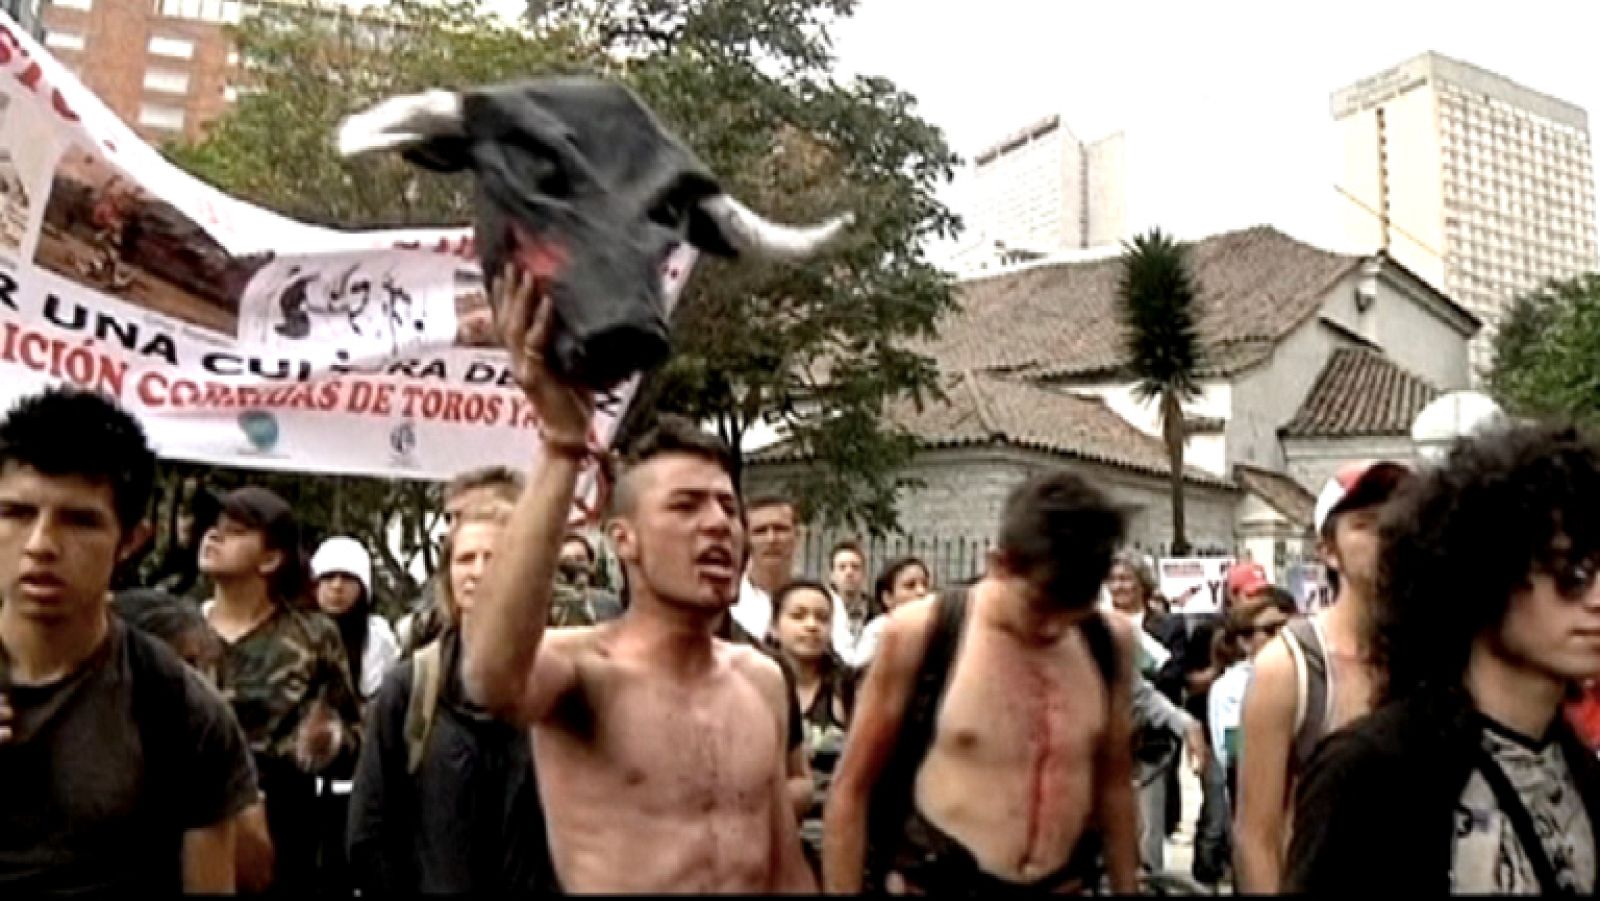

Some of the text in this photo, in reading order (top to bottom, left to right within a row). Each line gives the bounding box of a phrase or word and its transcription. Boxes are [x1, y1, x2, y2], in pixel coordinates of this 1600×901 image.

[43, 293, 178, 366] UNA
[202, 352, 446, 382] CURA
[347, 380, 396, 414] DE
[402, 386, 503, 425] TOROS
